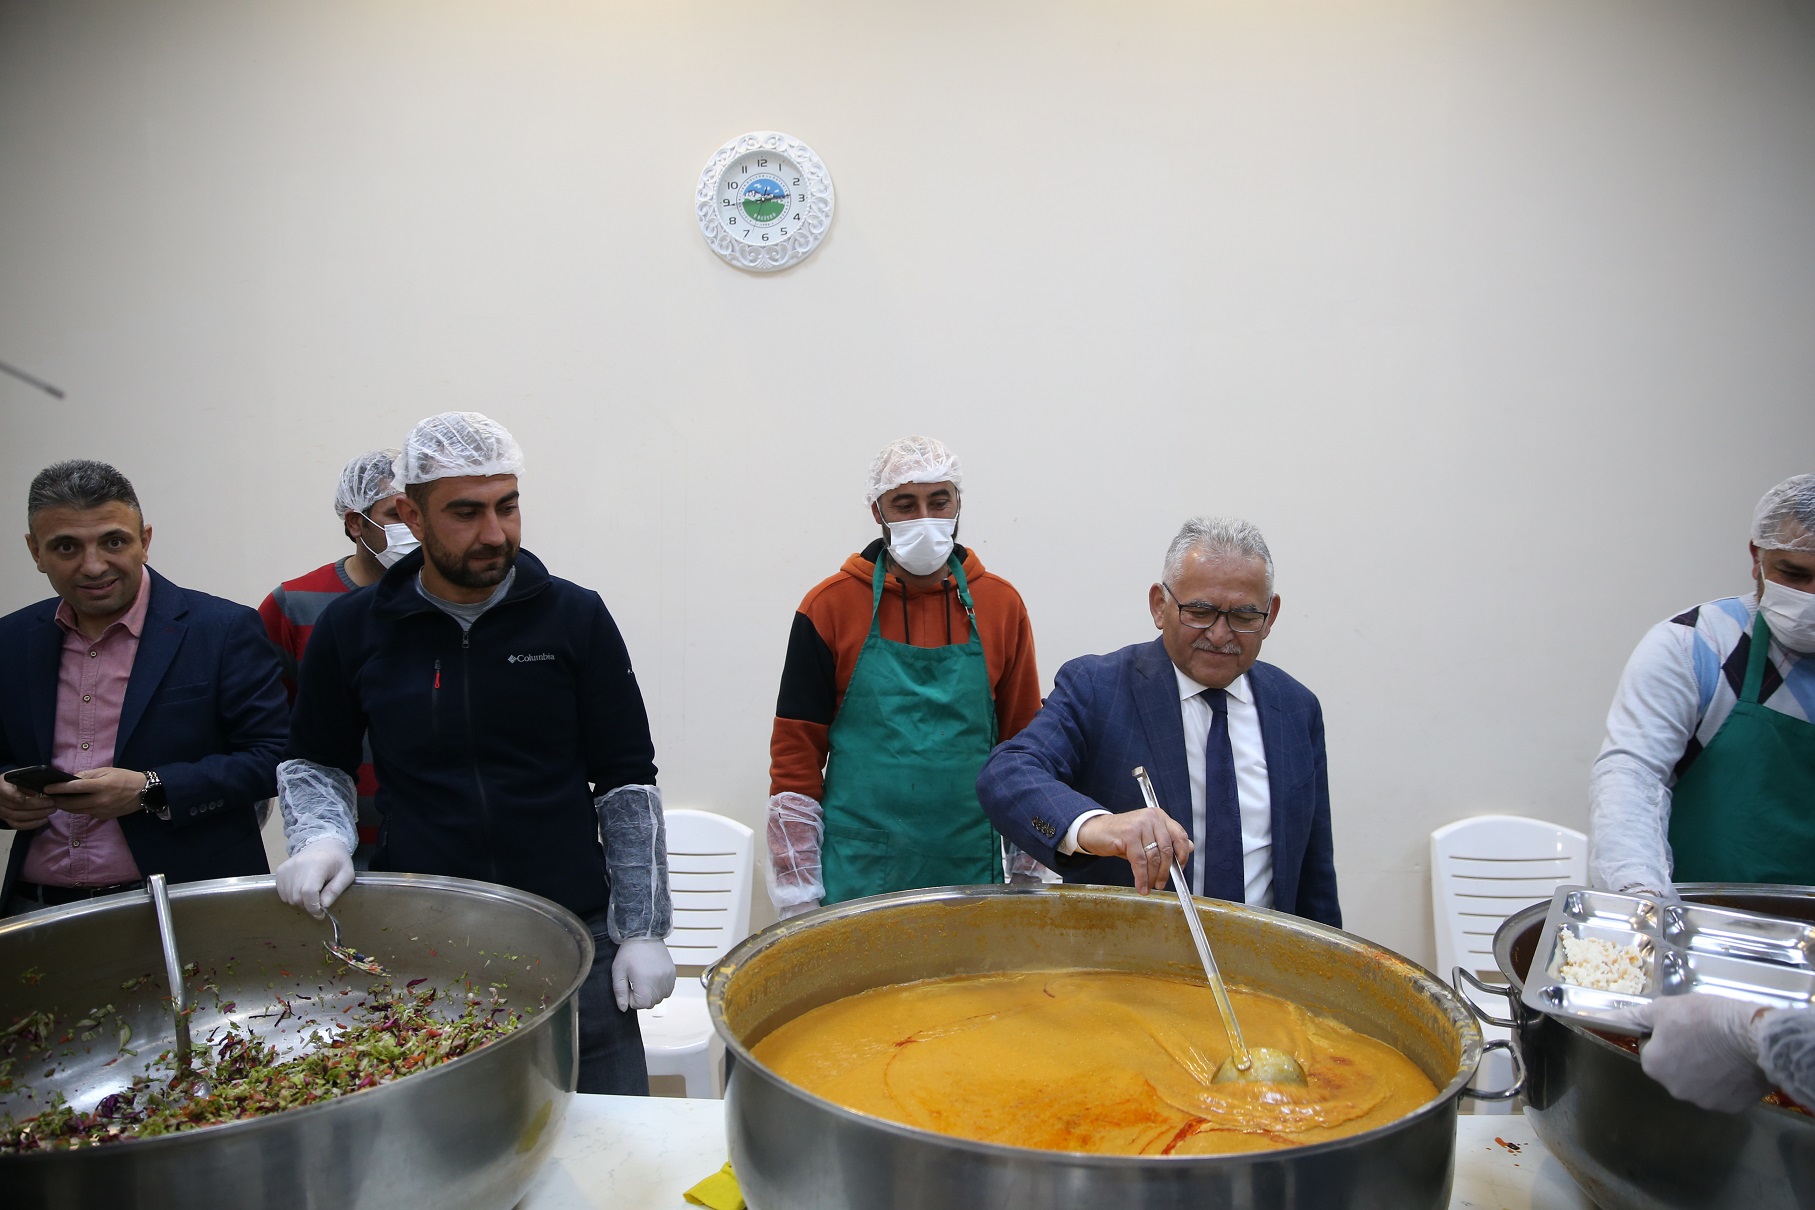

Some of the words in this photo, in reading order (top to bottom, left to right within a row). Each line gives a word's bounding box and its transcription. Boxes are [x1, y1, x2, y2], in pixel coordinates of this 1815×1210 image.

[757, 159, 768, 168] 12
[778, 163, 782, 172] 1
[741, 166, 748, 174] 11
[727, 181, 739, 190] 10
[792, 177, 800, 186] 2
[722, 198, 731, 207] 9
[798, 194, 805, 202] 3
[728, 216, 737, 225] 8
[793, 213, 801, 221] 4
[743, 229, 750, 238] 7
[780, 227, 788, 236] 5
[761, 233, 770, 242] 6
[516, 652, 555, 663] Columbia
